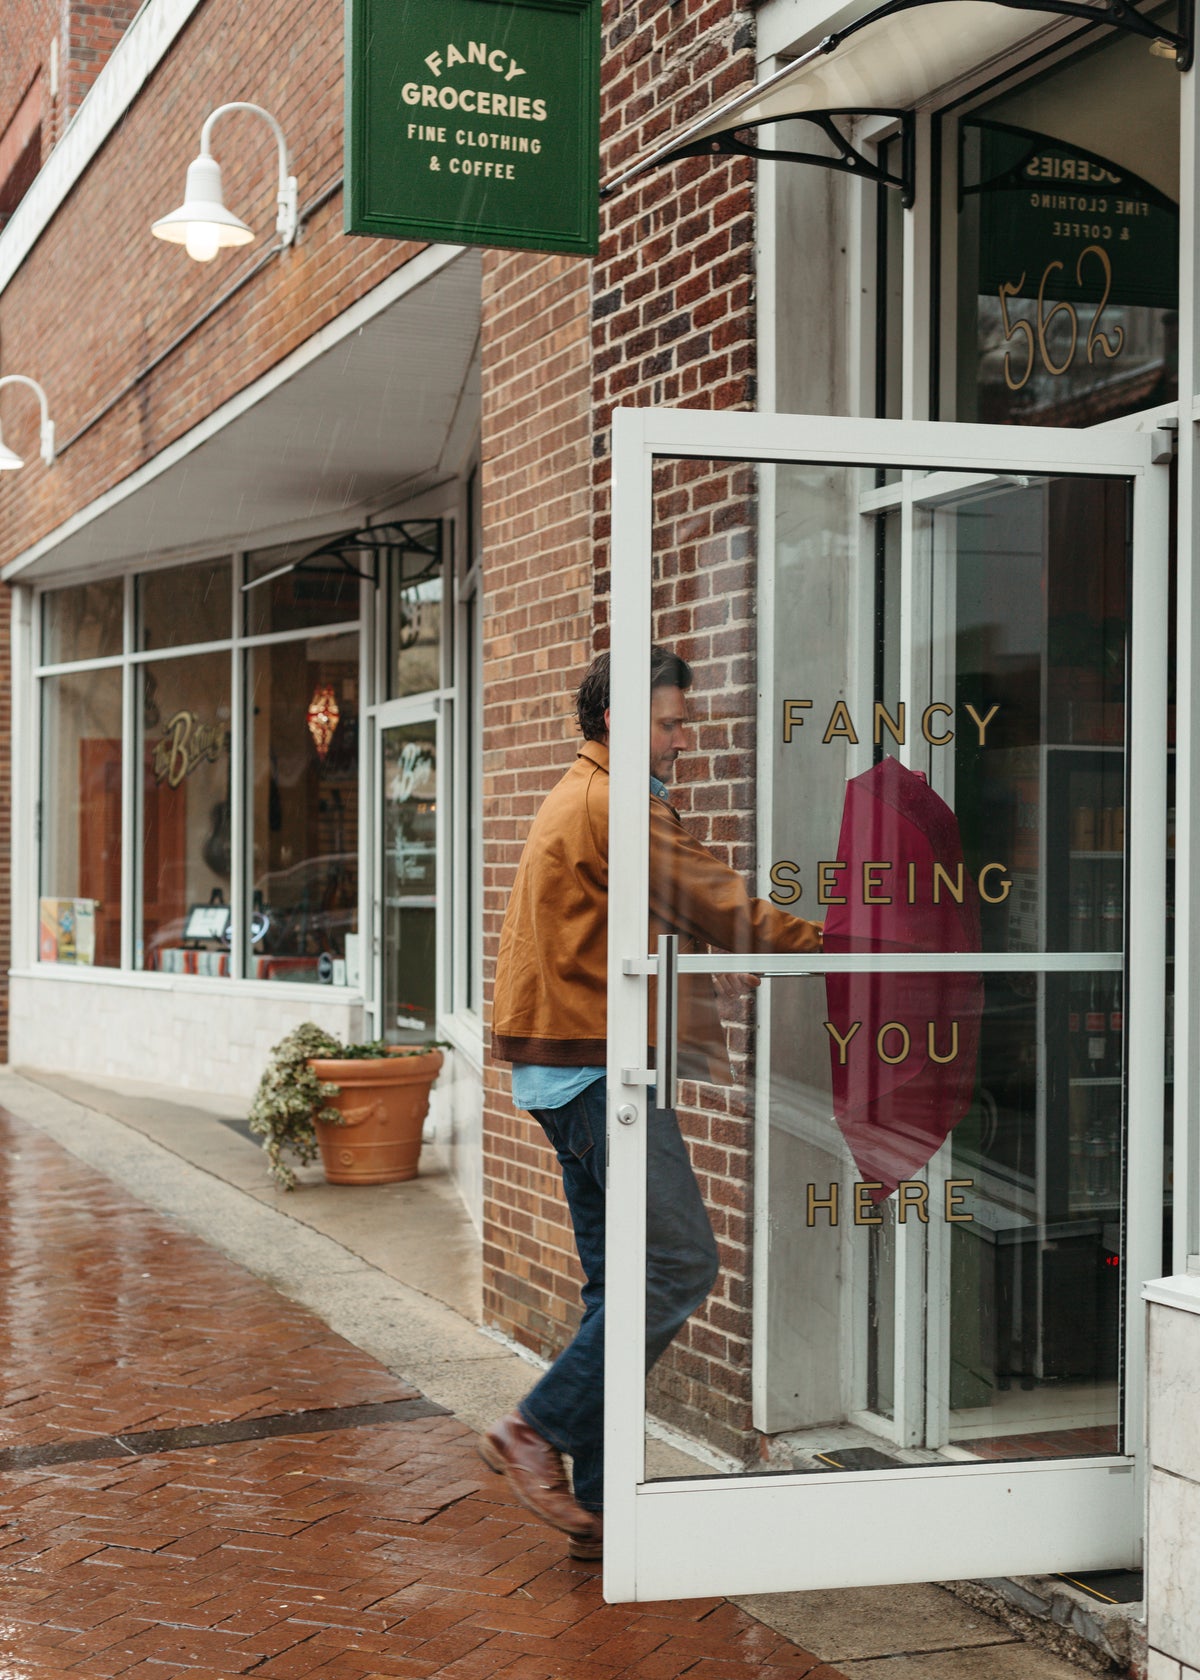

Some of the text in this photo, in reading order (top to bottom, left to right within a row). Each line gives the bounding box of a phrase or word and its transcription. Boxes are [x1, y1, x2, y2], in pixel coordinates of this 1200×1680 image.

[424, 41, 526, 81] FANCY
[401, 82, 548, 122] GROCERIES
[407, 124, 542, 155] FINE CLOTHING
[429, 156, 516, 180] & COFFEE
[999, 245, 1124, 391] 562
[783, 699, 1001, 746] FANCY
[768, 860, 1013, 905] SEEING
[823, 1021, 959, 1065] YOU
[806, 1179, 974, 1227] HERE
